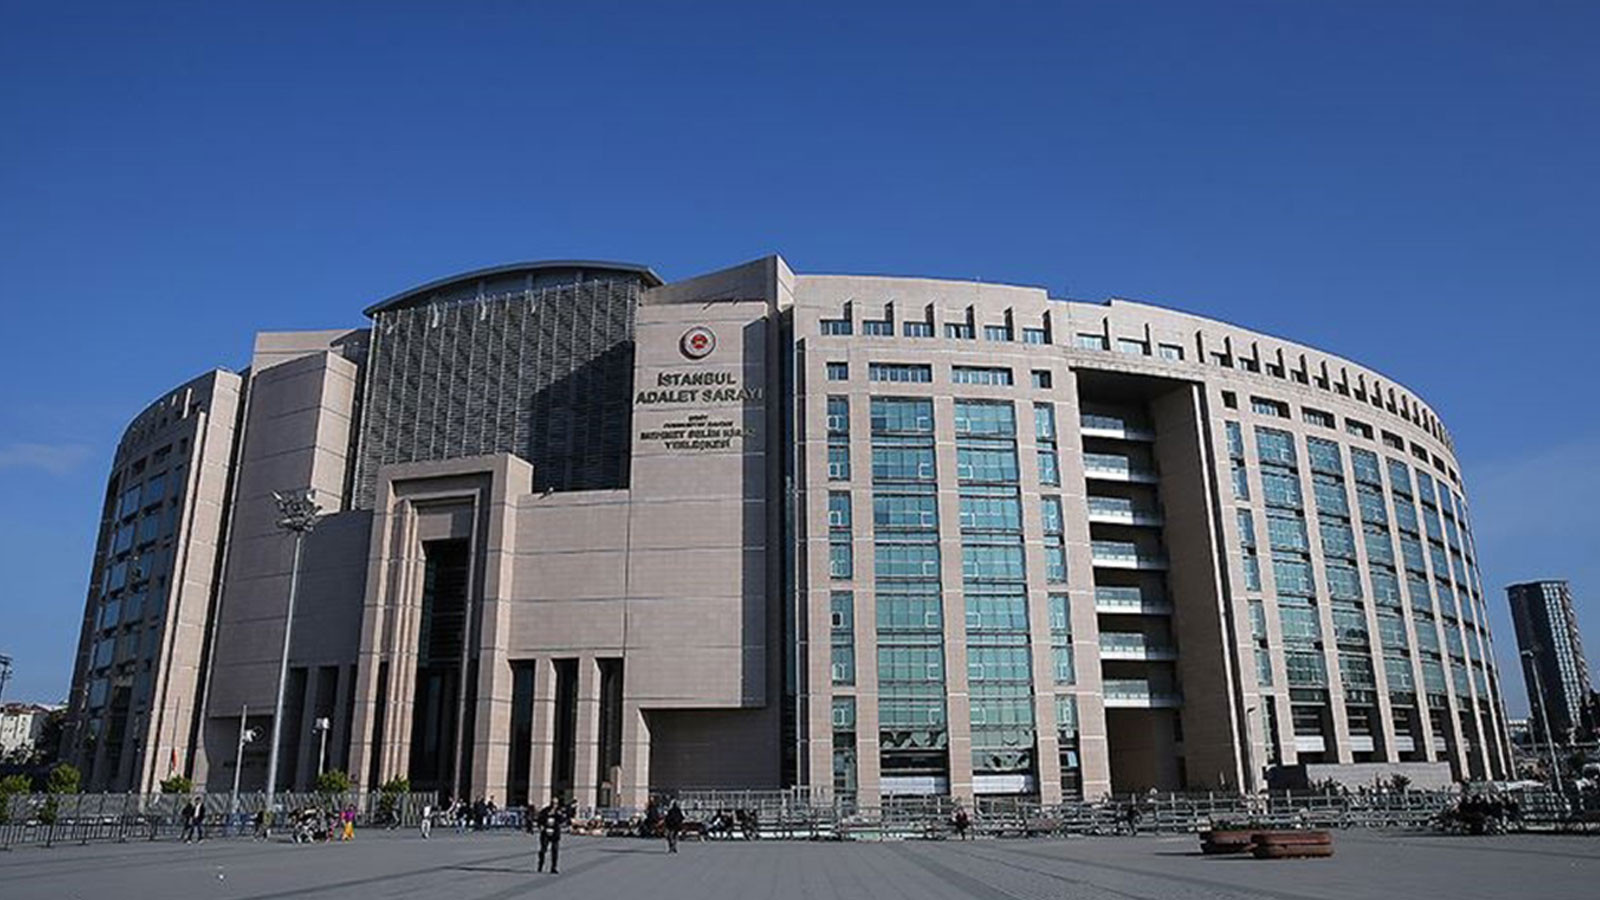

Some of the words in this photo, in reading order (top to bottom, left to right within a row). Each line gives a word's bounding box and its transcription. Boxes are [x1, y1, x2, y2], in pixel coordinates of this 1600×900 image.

[657, 372, 737, 387] İSTANBUL
[635, 390, 699, 405] ADALET
[702, 387, 763, 403] SARAYI
